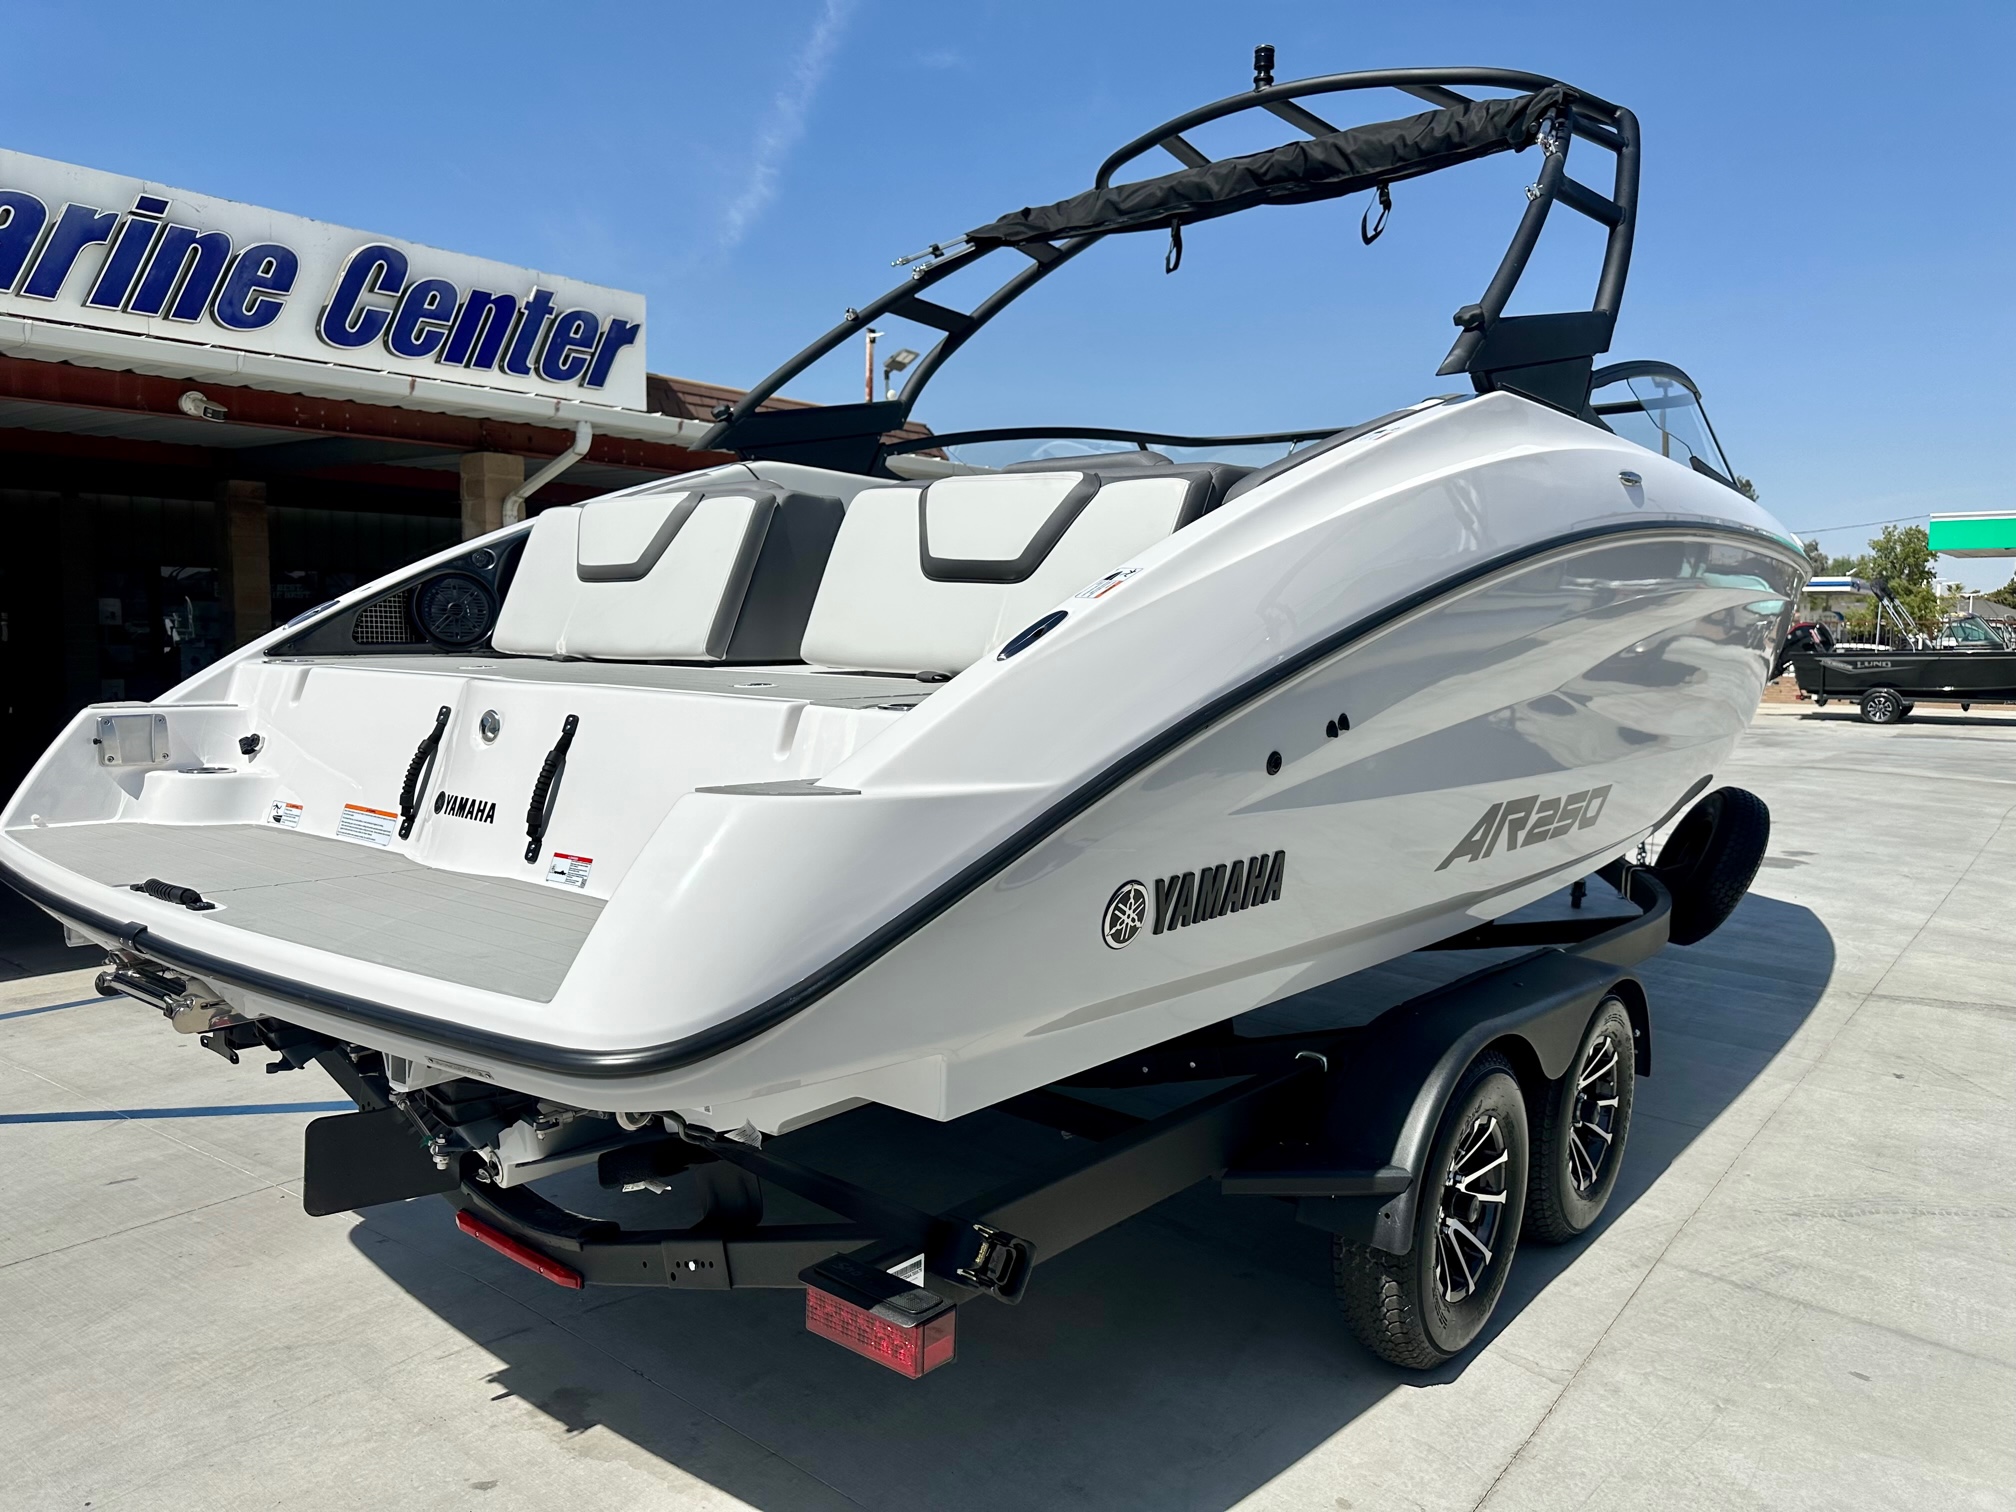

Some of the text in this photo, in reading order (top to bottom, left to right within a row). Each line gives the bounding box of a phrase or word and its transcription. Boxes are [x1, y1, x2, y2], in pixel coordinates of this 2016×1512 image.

[316, 242, 643, 391] Center
[444, 794, 496, 824] YAMAHA
[1433, 783, 1613, 872] AR250
[1152, 849, 1286, 935] YAMAHA
